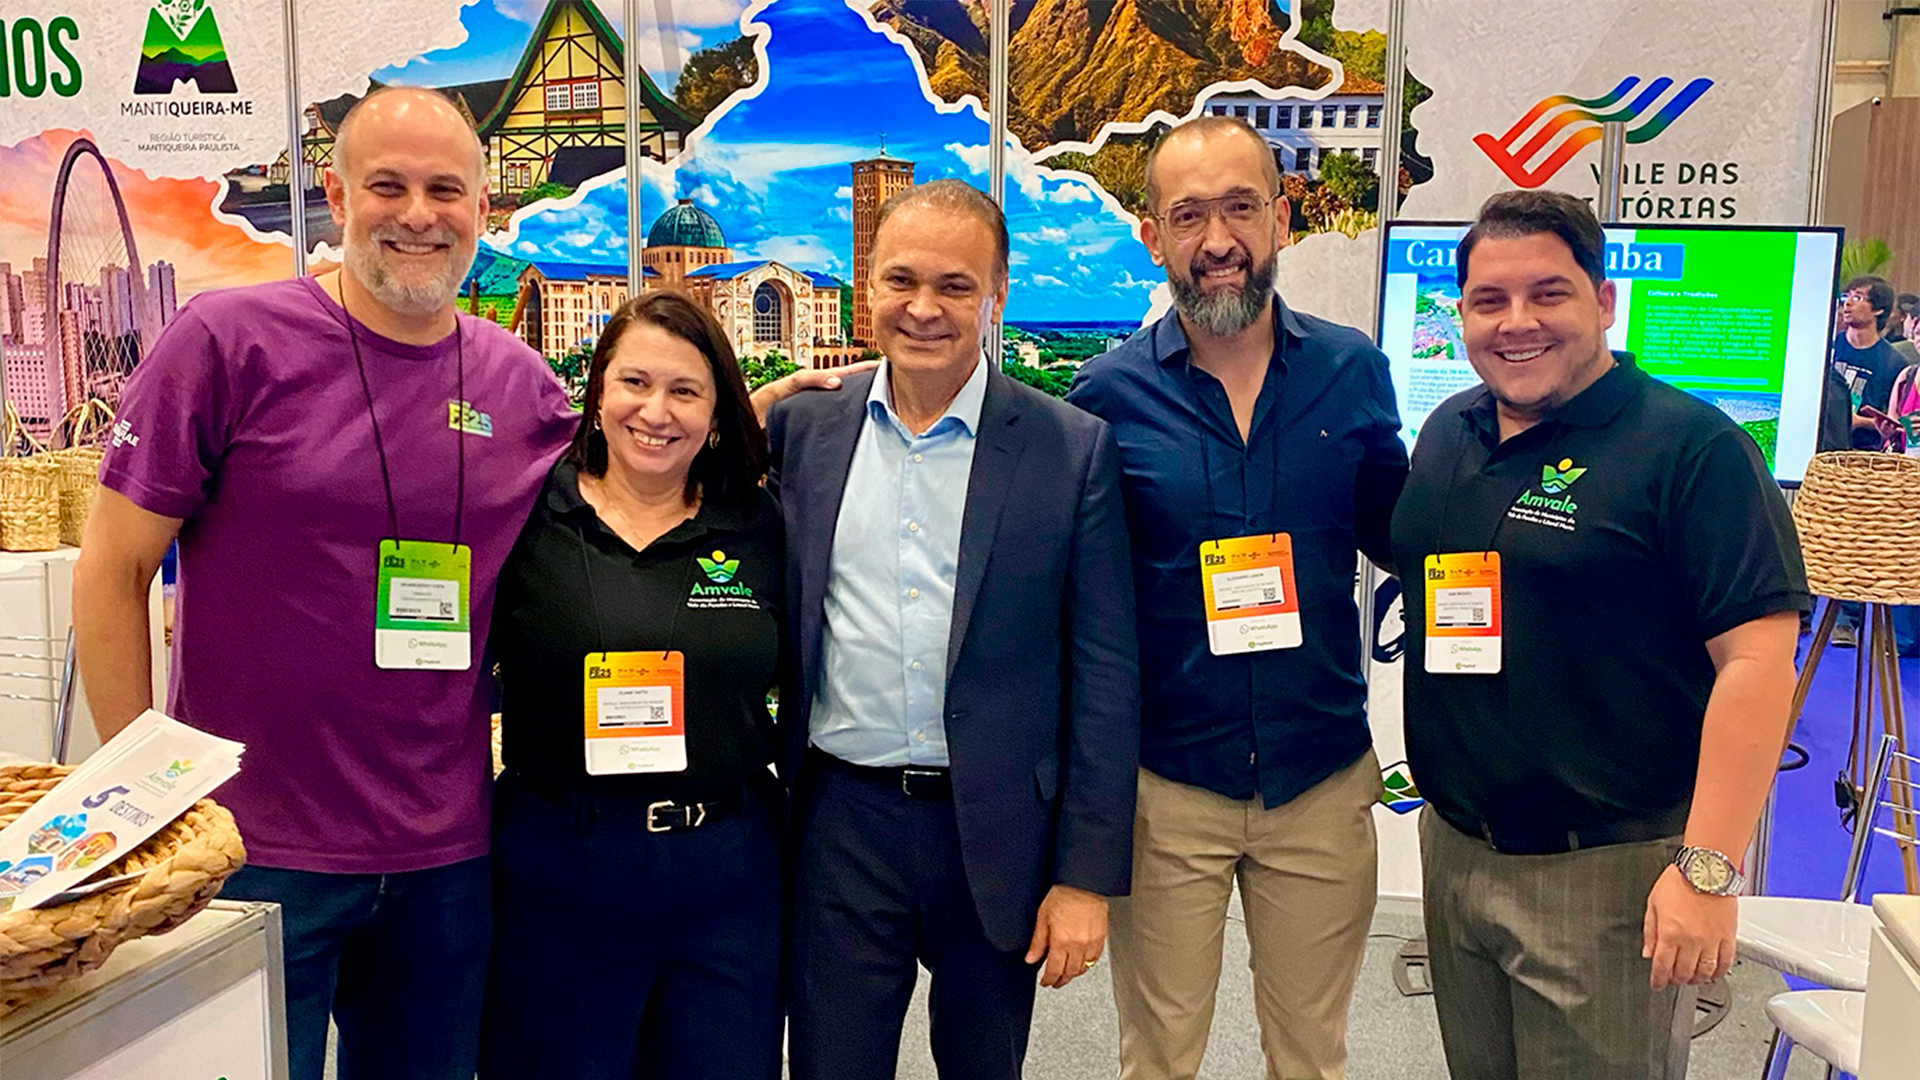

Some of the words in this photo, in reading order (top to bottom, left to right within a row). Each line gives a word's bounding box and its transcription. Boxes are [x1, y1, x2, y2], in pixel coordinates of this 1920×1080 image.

[121, 101, 253, 117] MANTIQUEIRA-ME
[138, 143, 197, 152] MANTIQUEIRA
[199, 143, 240, 151] PAULISTA
[1678, 162, 1739, 185] DAS
[1583, 190, 1736, 219] TÓRIAS
[1406, 240, 1457, 267] Car
[1516, 488, 1578, 514] Amvale
[690, 581, 753, 597] Amvale
[82, 785, 130, 808] 5
[109, 800, 154, 827] DESTINOS
